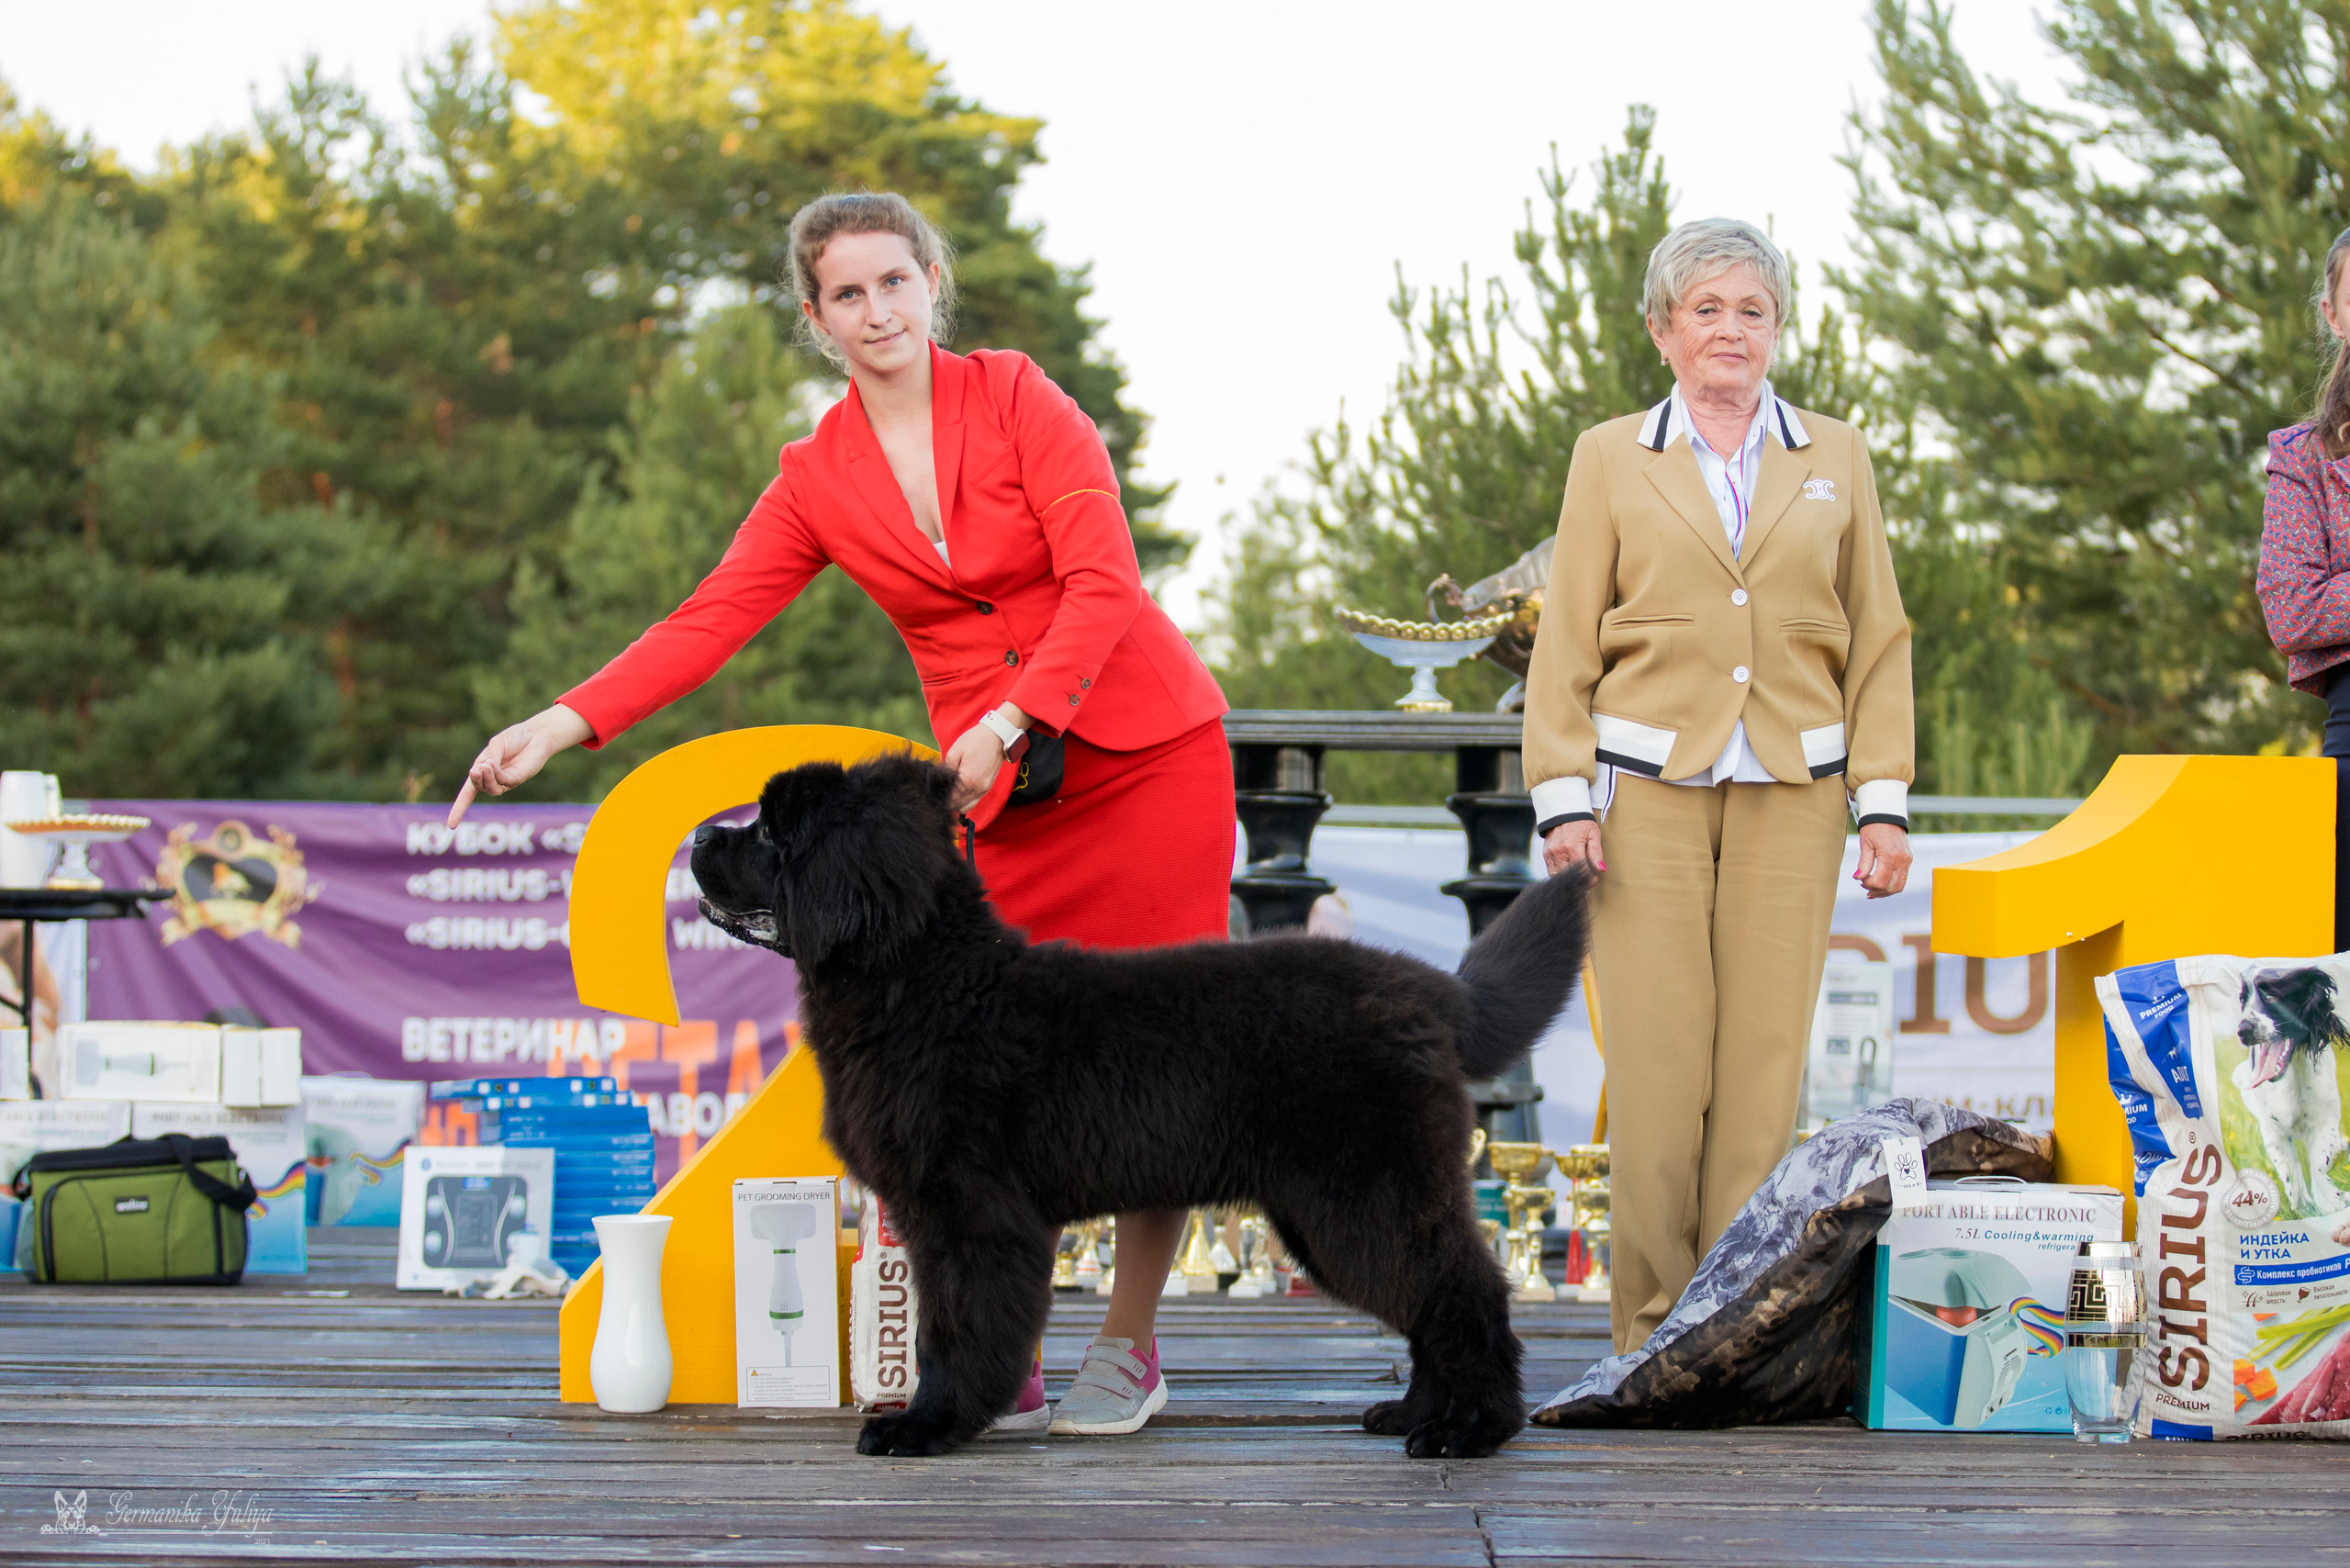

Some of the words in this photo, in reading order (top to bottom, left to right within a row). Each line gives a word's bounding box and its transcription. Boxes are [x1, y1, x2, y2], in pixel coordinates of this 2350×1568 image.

[406, 822, 536, 856] КУБОК
[405, 868, 573, 902] «SIRIUS-
[404, 916, 571, 951] «SIRIUS-
[2139, 992, 2182, 1020] PREMIUM
[2154, 1005, 2174, 1019] FOOD
[402, 1016, 626, 1063] ВЕТЕРИНАР
[2123, 1103, 2148, 1115] MIUM
[738, 1193, 753, 1202] PET
[754, 1193, 802, 1201] GROOMING
[803, 1192, 831, 1201] DRYER
[2231, 1189, 2268, 1208] 44%
[1903, 1204, 1944, 1219] PORT
[1947, 1205, 1989, 1220] ABLE
[1993, 1205, 2097, 1222] ELECTRONIC
[1954, 1227, 1981, 1239] 7.5L
[2240, 1230, 2310, 1247] ИНДЕЙКА
[2037, 1242, 2076, 1252] refrigera
[2240, 1249, 2250, 1260] И
[2254, 1249, 2291, 1260] УТКА
[2157, 1143, 2222, 1391] SIRIUS
[2256, 1270, 2296, 1279] Комплекс
[2296, 1262, 2342, 1279] пробиотиков
[878, 1260, 909, 1388] SIRIUS
[2155, 1393, 2210, 1411] PREMIUM
